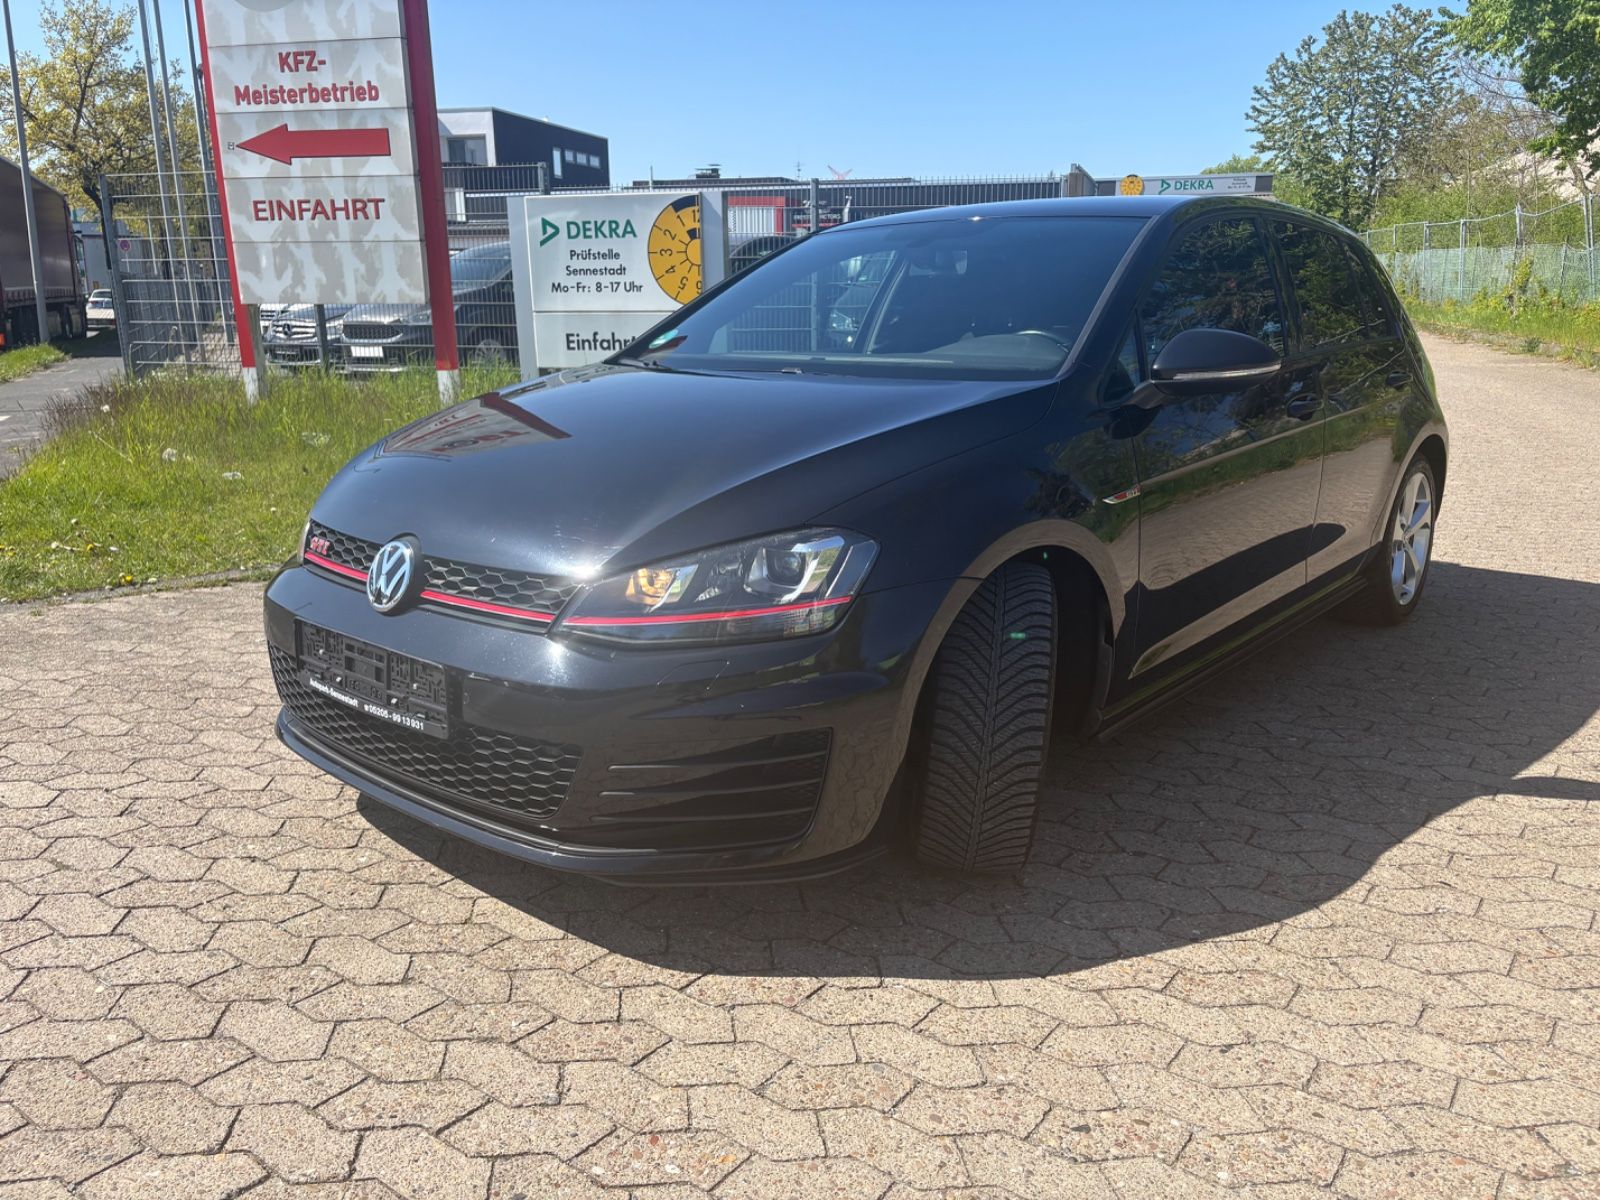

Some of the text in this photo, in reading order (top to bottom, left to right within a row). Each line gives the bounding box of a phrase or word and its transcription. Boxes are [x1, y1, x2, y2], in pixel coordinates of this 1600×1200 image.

[278, 50, 326, 73] KFZ-
[234, 80, 380, 106] Meisterbetrieb
[1174, 179, 1214, 191] DEKRA
[252, 198, 385, 221] EINFAHRT
[566, 219, 637, 240] DEKRA
[569, 248, 621, 261] Prüfstelle
[565, 264, 627, 276] Sennestadt
[551, 281, 644, 293] Mo-Fr: 8-17 Uhr
